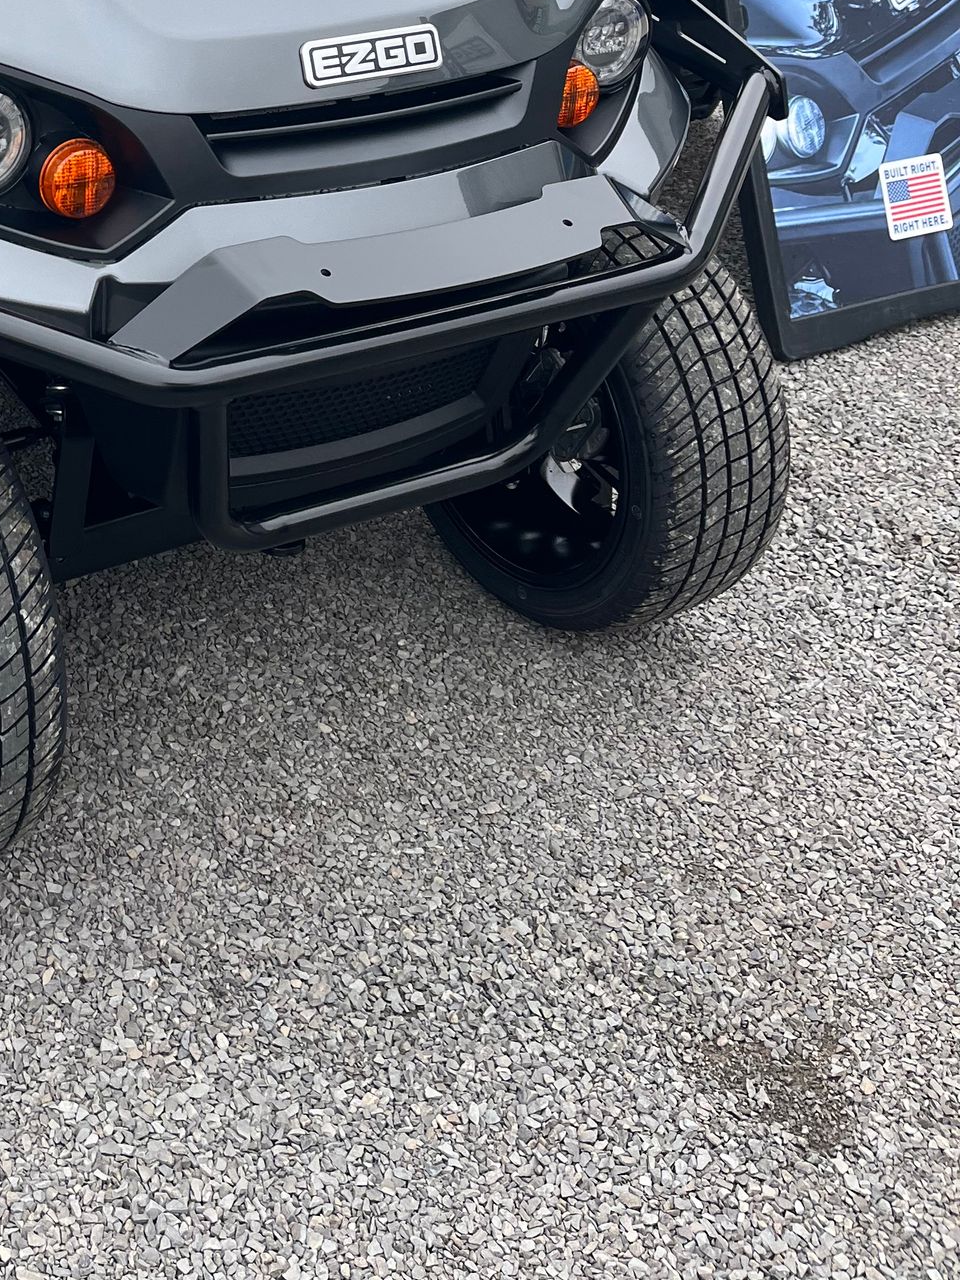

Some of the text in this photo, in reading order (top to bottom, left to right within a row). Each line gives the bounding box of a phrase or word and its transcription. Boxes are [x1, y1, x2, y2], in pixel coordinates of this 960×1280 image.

[311, 32, 437, 79] EZGO
[883, 166, 908, 180] BUILT
[893, 220, 919, 234] RIGHT
